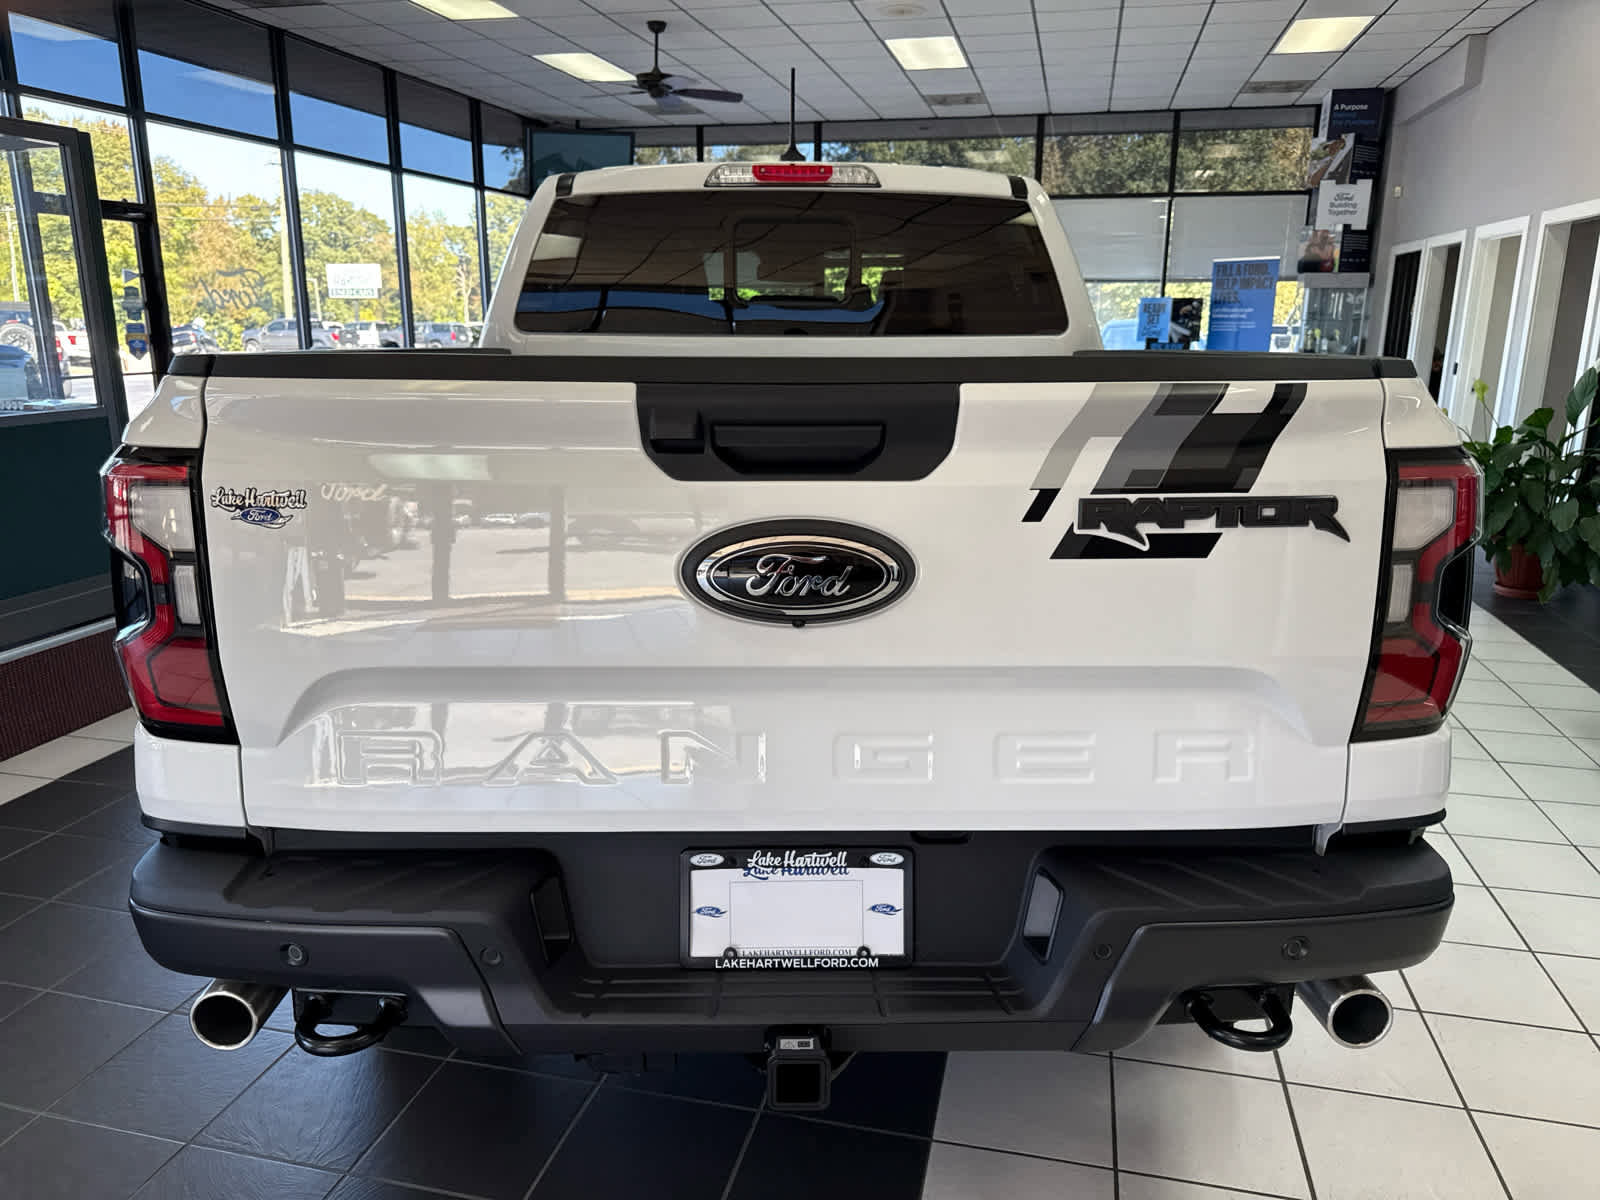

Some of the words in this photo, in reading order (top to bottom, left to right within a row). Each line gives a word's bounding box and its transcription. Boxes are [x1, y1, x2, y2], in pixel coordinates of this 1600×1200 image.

[1329, 201, 1358, 210] Building
[210, 486, 244, 512] Lake
[243, 487, 308, 509] Hartwell
[247, 510, 273, 521] Ford
[1078, 495, 1351, 549] RAPTOR
[745, 553, 853, 597] Ford
[335, 729, 1254, 785] RANGER
[697, 855, 718, 864] Ford
[747, 850, 782, 871] Lake
[783, 850, 847, 867] Hartwell
[876, 854, 897, 863] Ford
[741, 948, 853, 957] LAKEHARTWELLFORD.COM
[715, 957, 879, 969] LAKEHARTWELLFORD.COM
